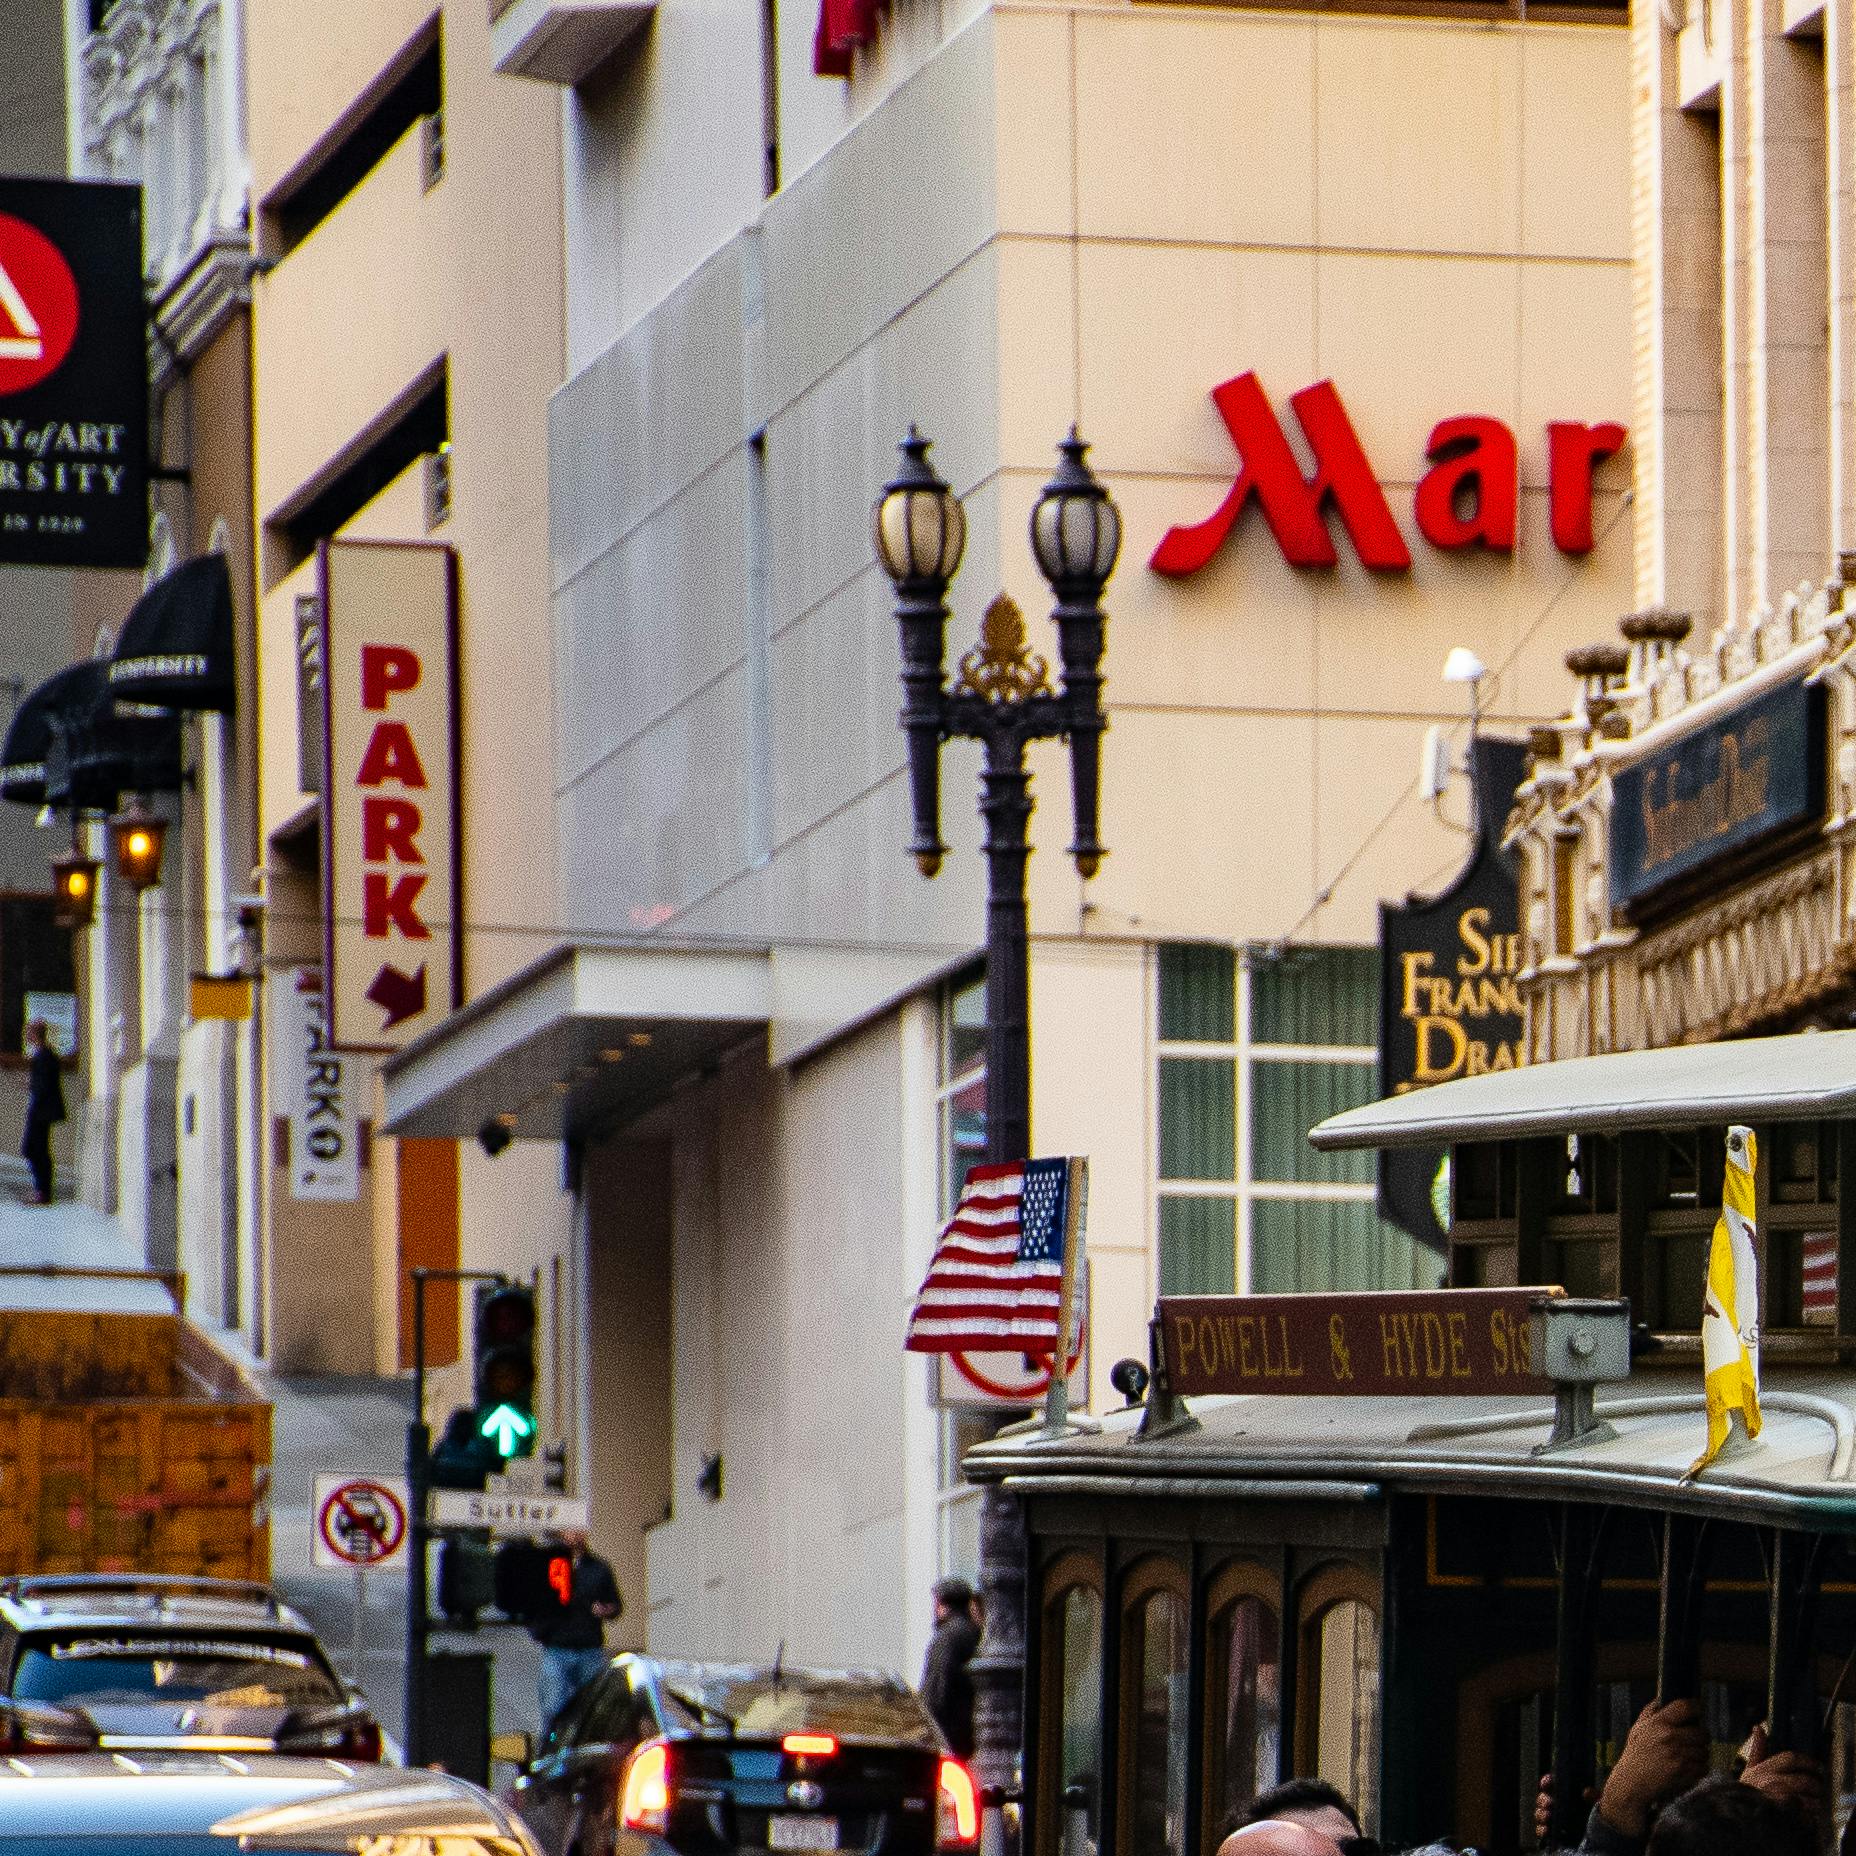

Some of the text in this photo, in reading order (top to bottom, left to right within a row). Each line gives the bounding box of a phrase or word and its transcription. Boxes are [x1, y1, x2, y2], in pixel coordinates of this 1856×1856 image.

[357, 644, 432, 940] PARK
[1176, 1315, 1303, 1378] POWELL
[1329, 1313, 1353, 1381] &
[1379, 1312, 1472, 1378] HYDE
